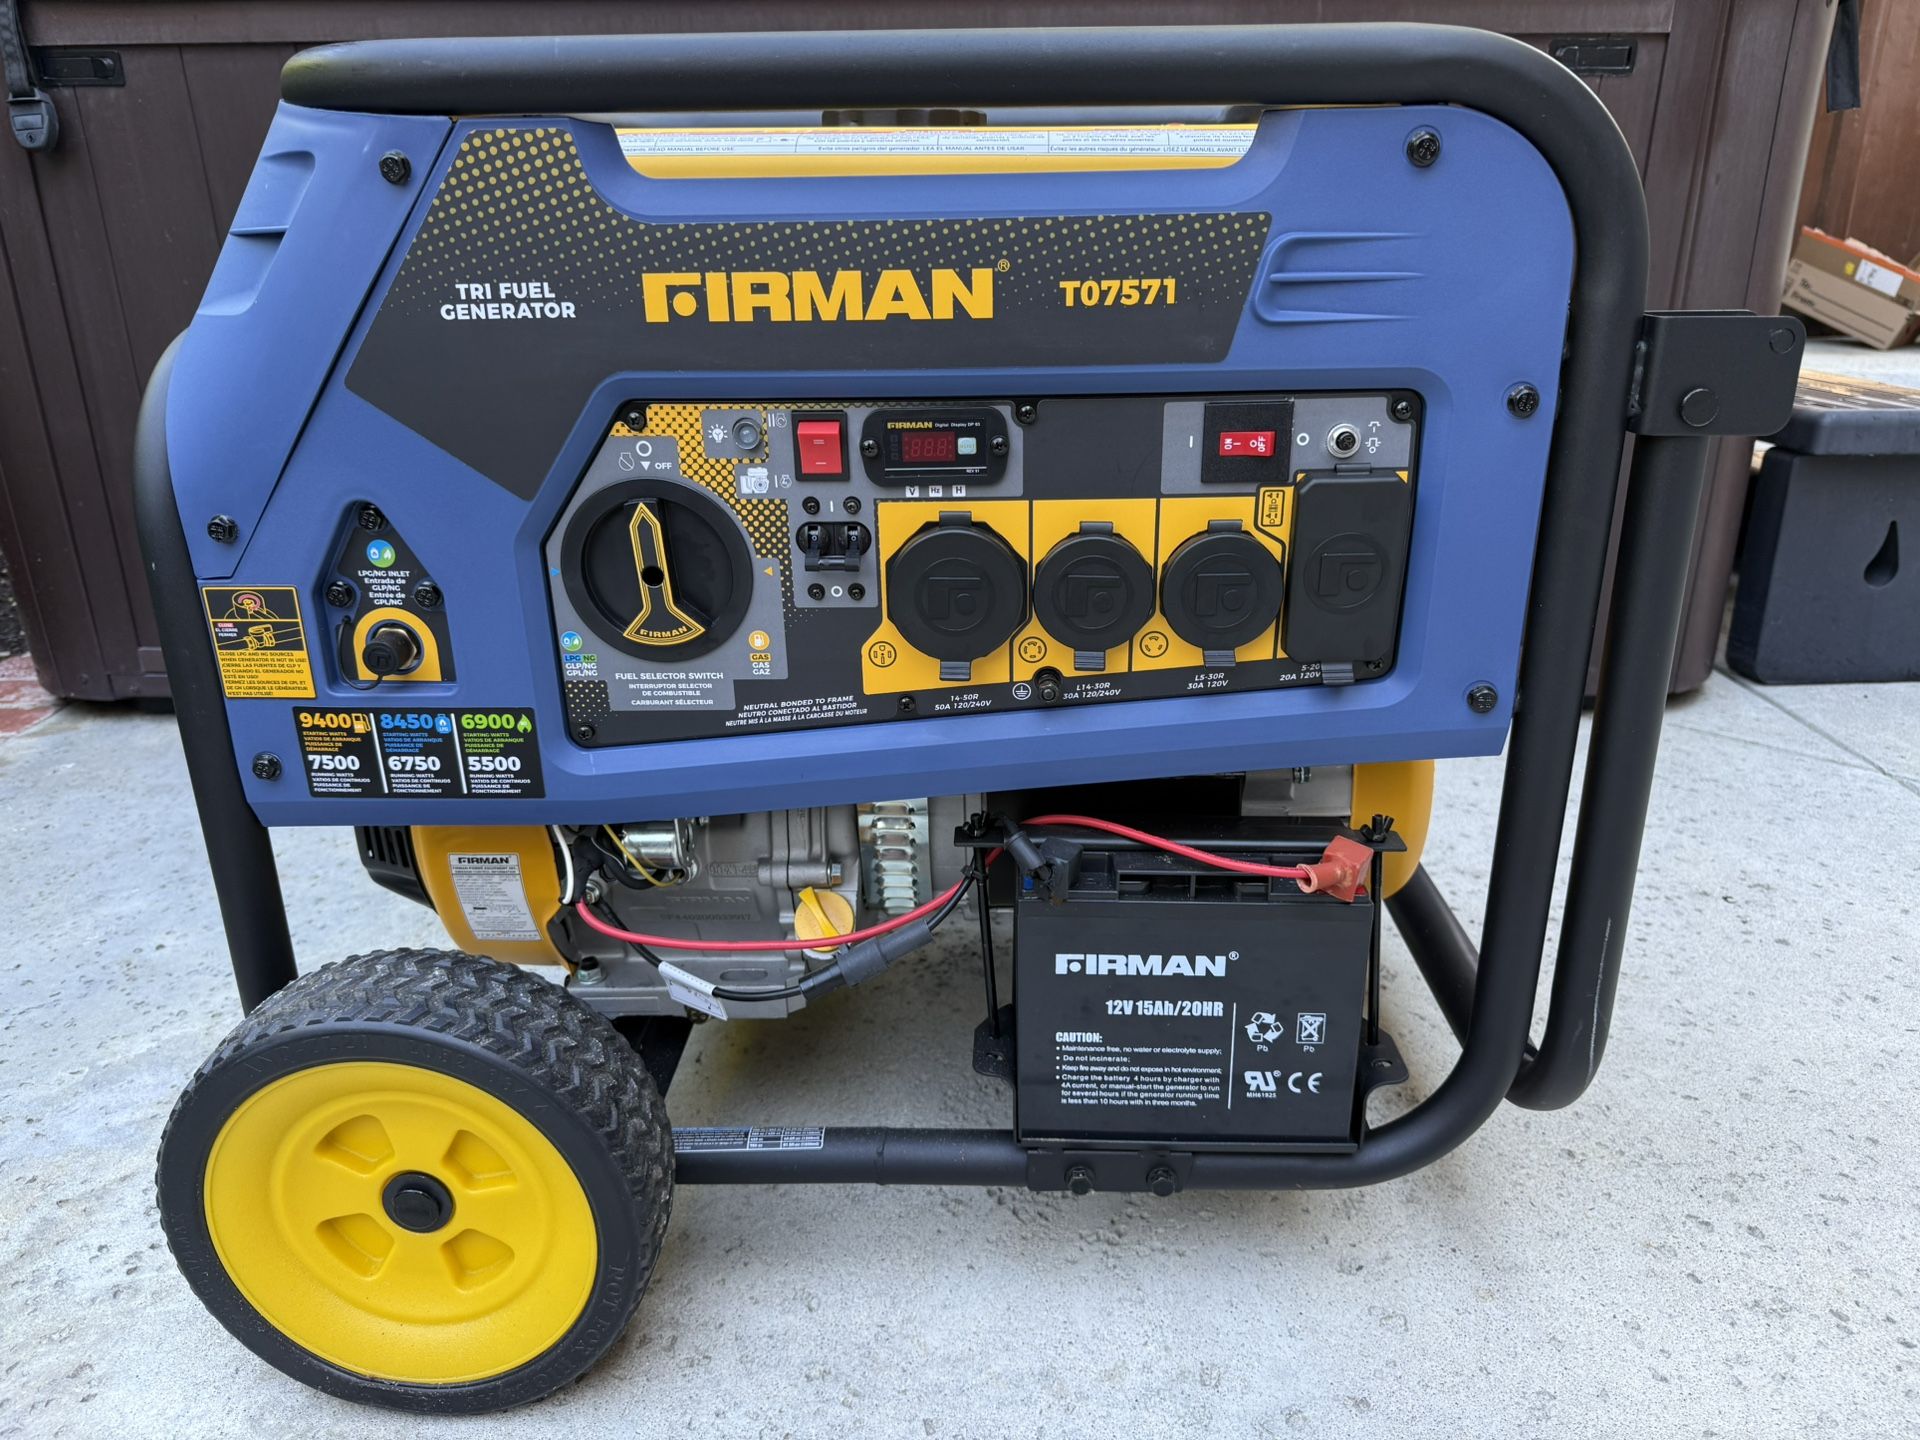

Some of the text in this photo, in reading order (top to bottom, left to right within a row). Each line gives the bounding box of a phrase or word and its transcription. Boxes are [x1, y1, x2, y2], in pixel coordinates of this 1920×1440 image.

[455, 282, 556, 300] TRI FUEL
[1060, 278, 1176, 307] T07571
[440, 302, 576, 320] GENERATOR
[1224, 438, 1232, 450] ON
[1258, 436, 1266, 452] OFF
[654, 462, 672, 470] OFF
[615, 672, 724, 680] FUEL SELECTOR SWITCH
[1194, 673, 1224, 682] L5-30R
[1280, 674, 1297, 682] 20A
[1076, 682, 1111, 691] L14-30R
[1206, 680, 1228, 688] 120V
[950, 694, 979, 702] 14-50R
[1063, 689, 1122, 700] 30A 120/240V
[744, 702, 778, 710] NEUTRAL
[781, 700, 813, 708] BONDED
[828, 696, 854, 704] FRAME
[953, 700, 992, 710] 120/240V
[738, 710, 766, 718] NEUTRO
[768, 706, 810, 716] CONECTADO
[822, 702, 858, 710] BASTIDOR
[300, 712, 352, 728] 9400
[380, 714, 432, 728] 8450
[462, 714, 515, 729] 6900
[773, 715, 790, 723] MASSE
[806, 712, 834, 720] CARCASSE
[308, 754, 360, 770] 7500
[388, 756, 440, 771] 6750
[467, 756, 522, 771] 5500
[1105, 1000, 1223, 1016] 12V 15Ah/20HR
[1055, 1032, 1103, 1043] CAUTION:
[1106, 1045, 1122, 1053] free,
[1161, 1046, 1196, 1054] electrolyte
[1061, 1064, 1079, 1072] Keep
[1061, 1074, 1090, 1082] Charge
[1104, 1074, 1130, 1083] battery
[1162, 1076, 1172, 1084] by
[1173, 1076, 1202, 1084] charger
[1288, 1072, 1323, 1094] CE
